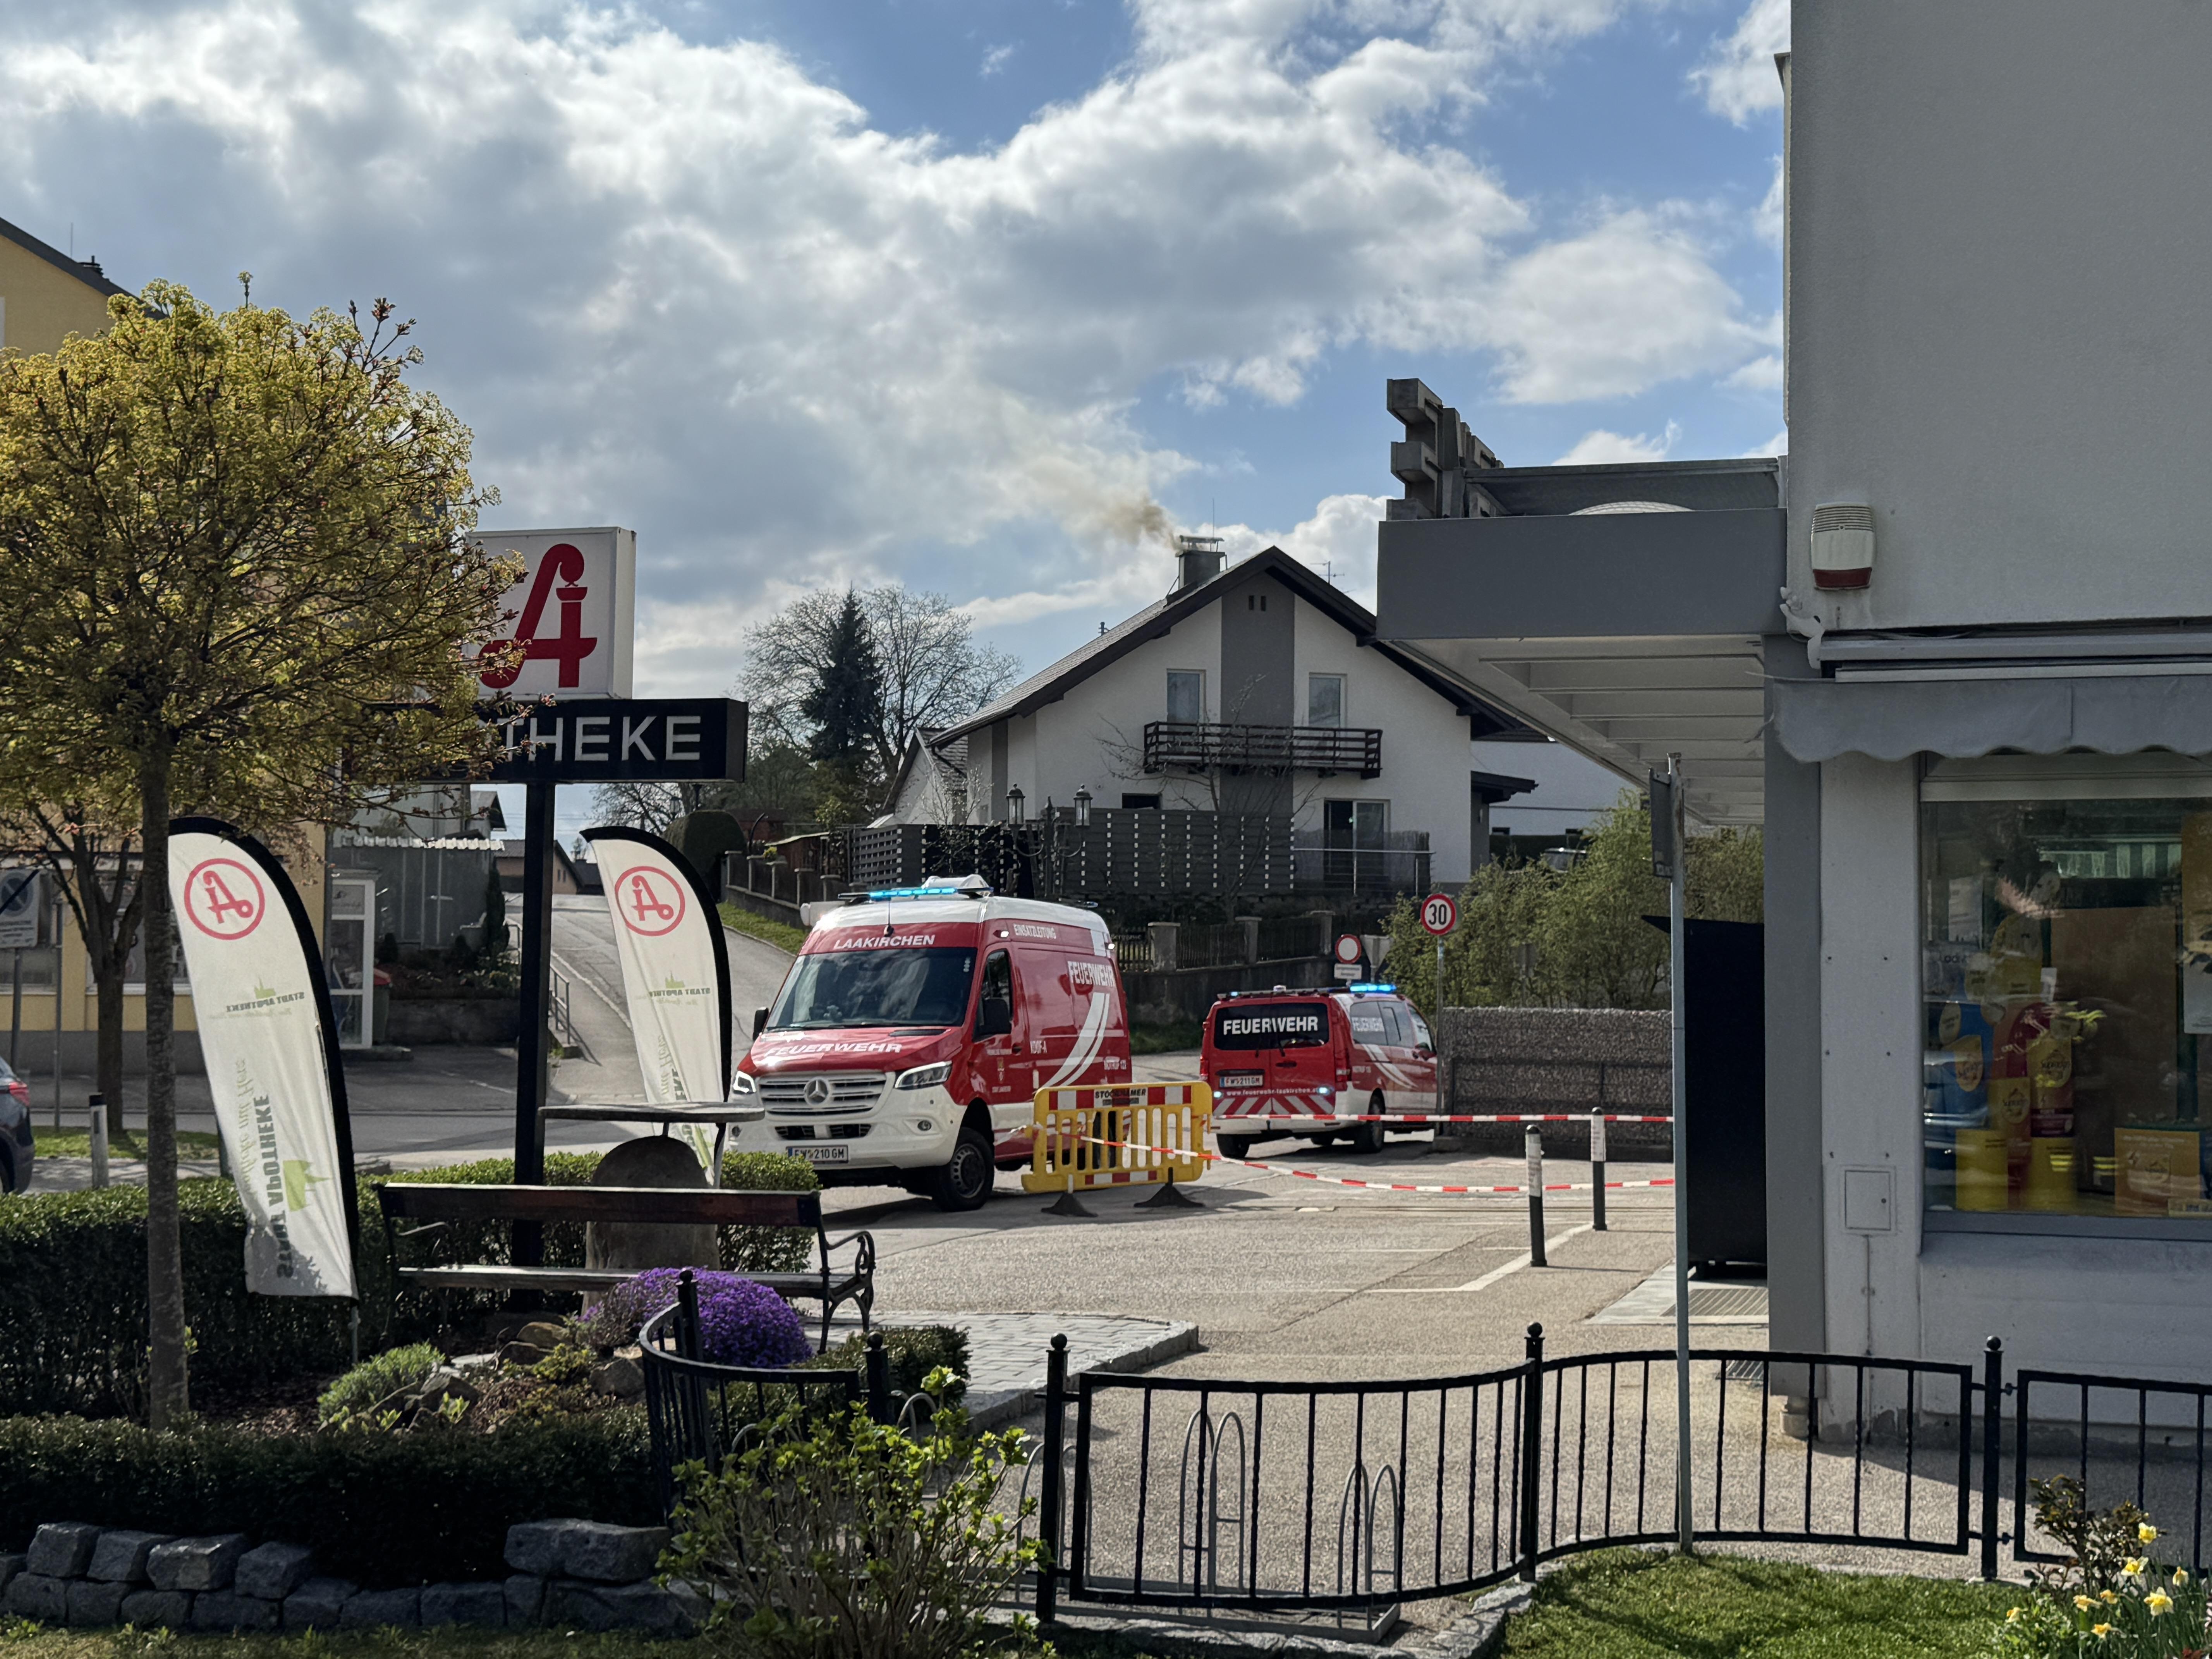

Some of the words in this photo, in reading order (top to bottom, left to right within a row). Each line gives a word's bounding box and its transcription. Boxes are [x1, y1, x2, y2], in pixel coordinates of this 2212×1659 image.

[1428, 903, 1447, 926] 30
[833, 934, 936, 949] LAAKIRCHEN
[1067, 960, 1116, 987] FEUERWEHR
[1223, 1016, 1318, 1036] FEUERWEHR
[764, 1042, 902, 1057] FEUERWEHR
[814, 1149, 830, 1159] 210
[832, 1149, 844, 1159] GM
